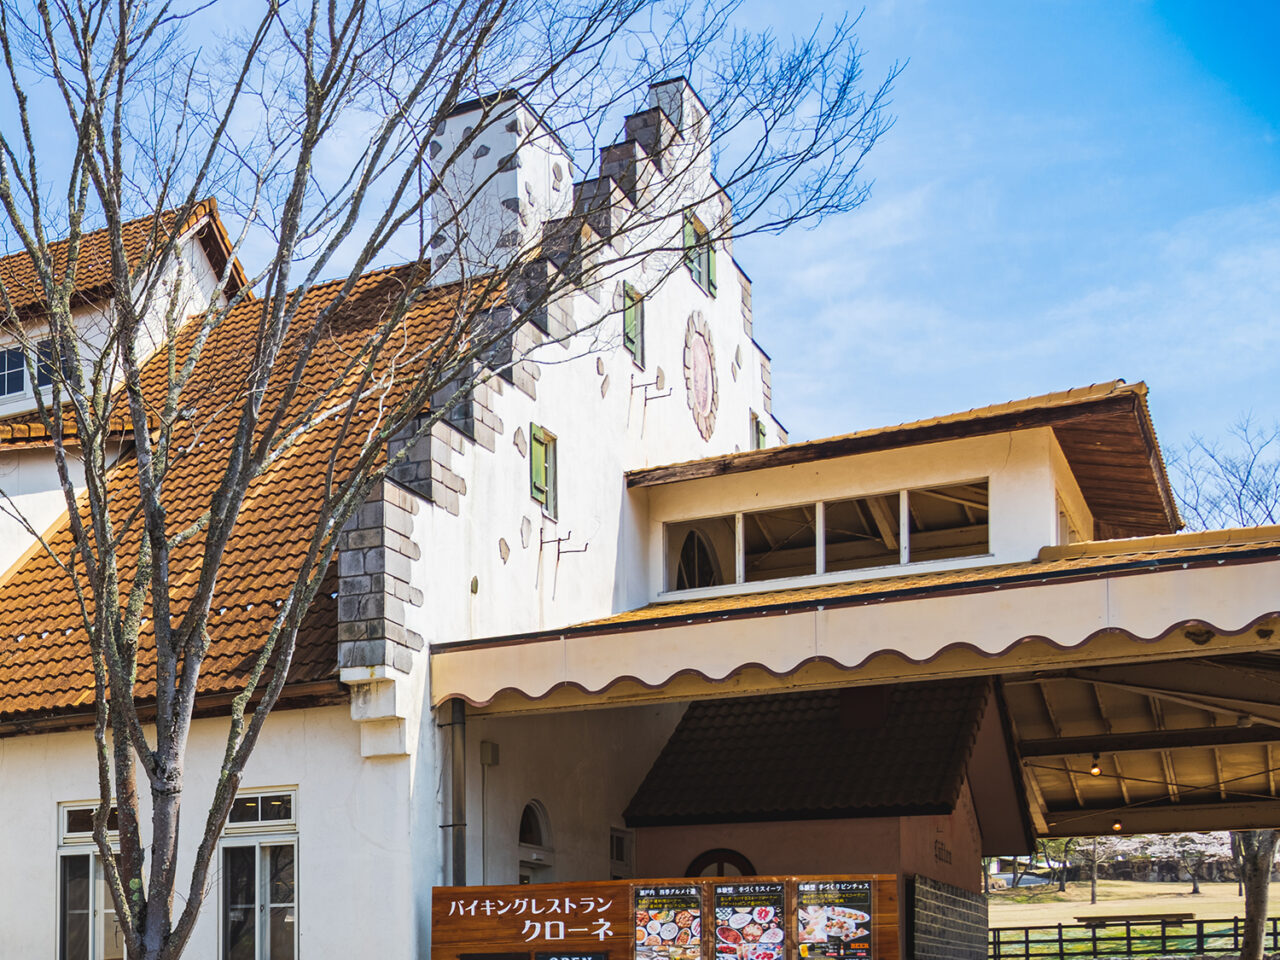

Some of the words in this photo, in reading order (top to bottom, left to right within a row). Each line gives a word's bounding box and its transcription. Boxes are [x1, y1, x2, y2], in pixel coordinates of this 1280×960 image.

[448, 896, 613, 917] バイキングレストラン
[521, 917, 614, 943] クローネ
